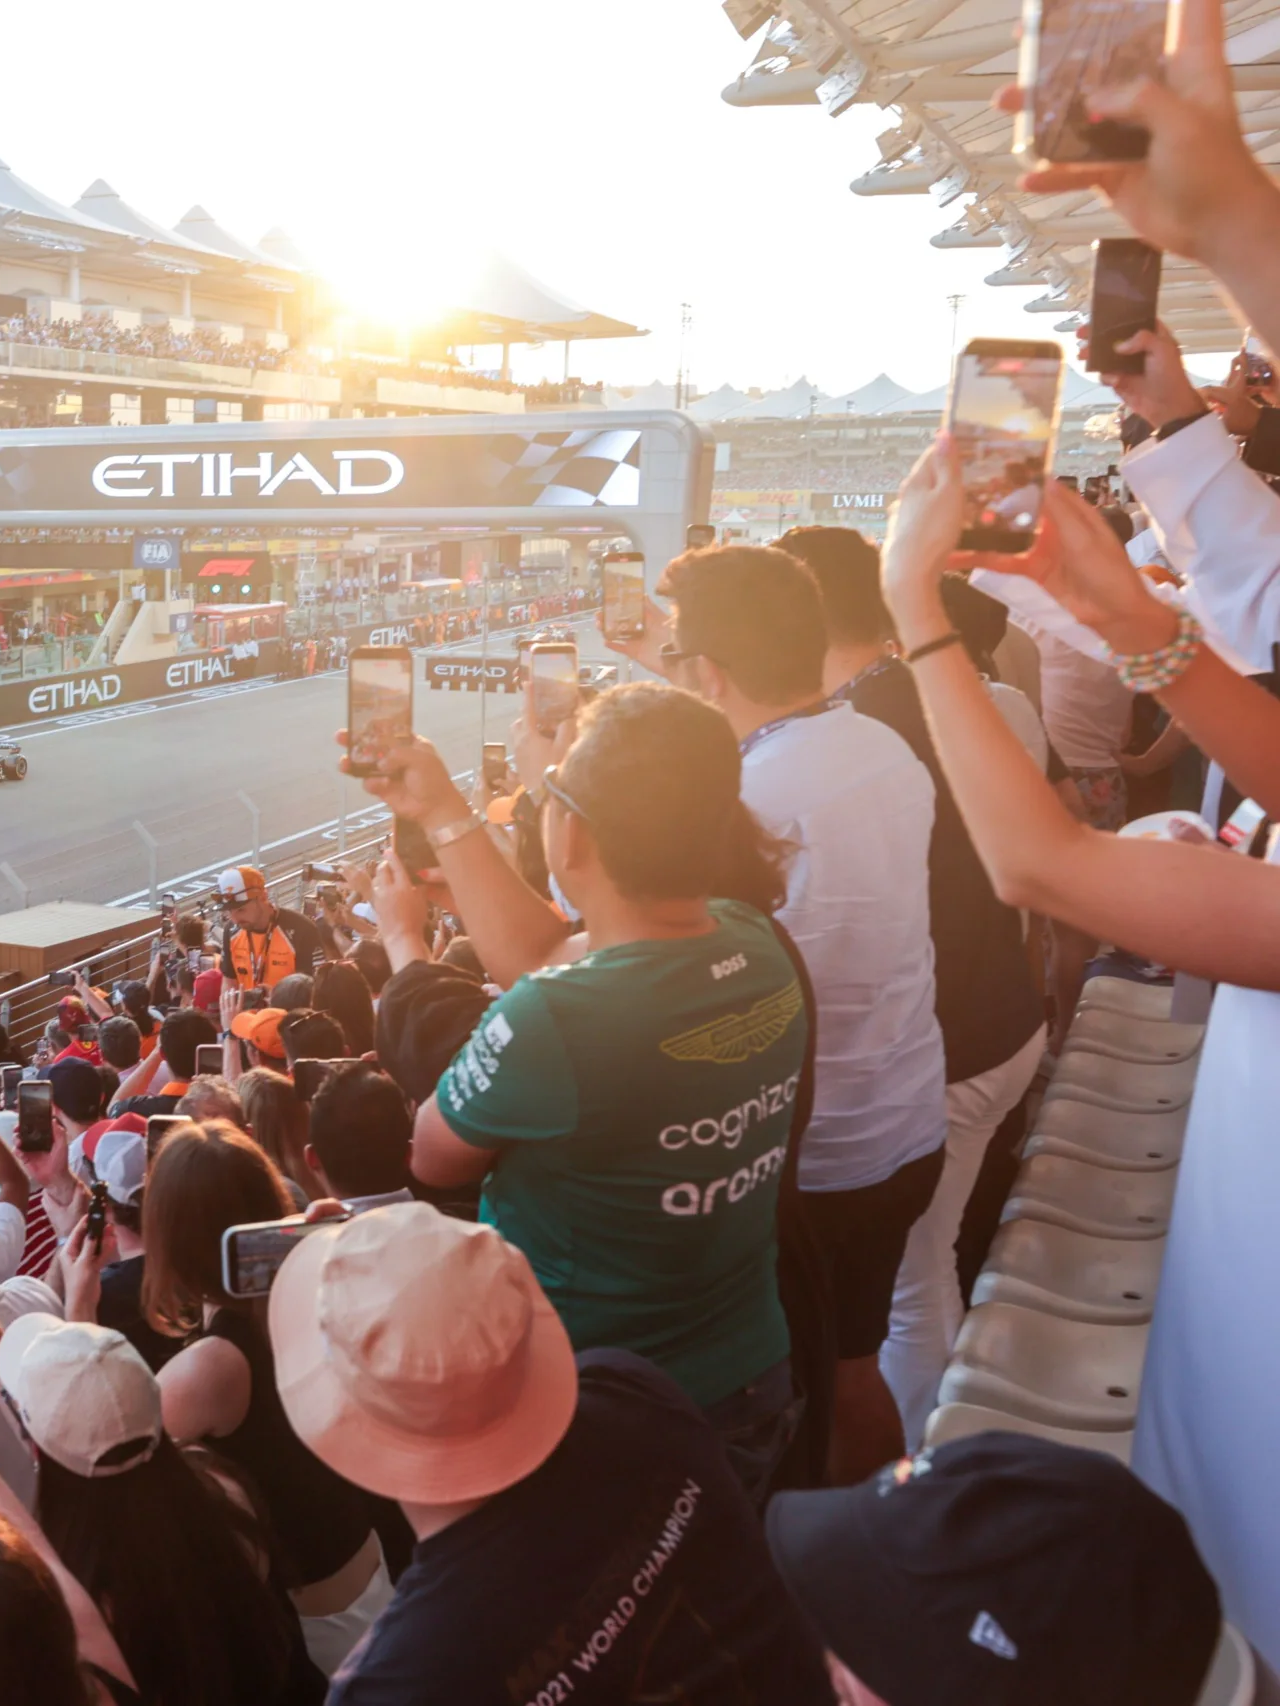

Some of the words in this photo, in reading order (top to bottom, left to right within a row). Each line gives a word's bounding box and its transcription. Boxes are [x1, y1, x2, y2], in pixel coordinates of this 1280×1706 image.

[92, 450, 404, 497] ETIHAD
[833, 494, 884, 509] LVMH
[141, 543, 169, 560] FIA
[433, 663, 508, 679] ETIHAD
[28, 674, 122, 715] ETIHAD
[710, 952, 748, 981] BOSS
[572, 1596, 637, 1673] WORLD
[632, 1477, 703, 1597] CHAMPION
